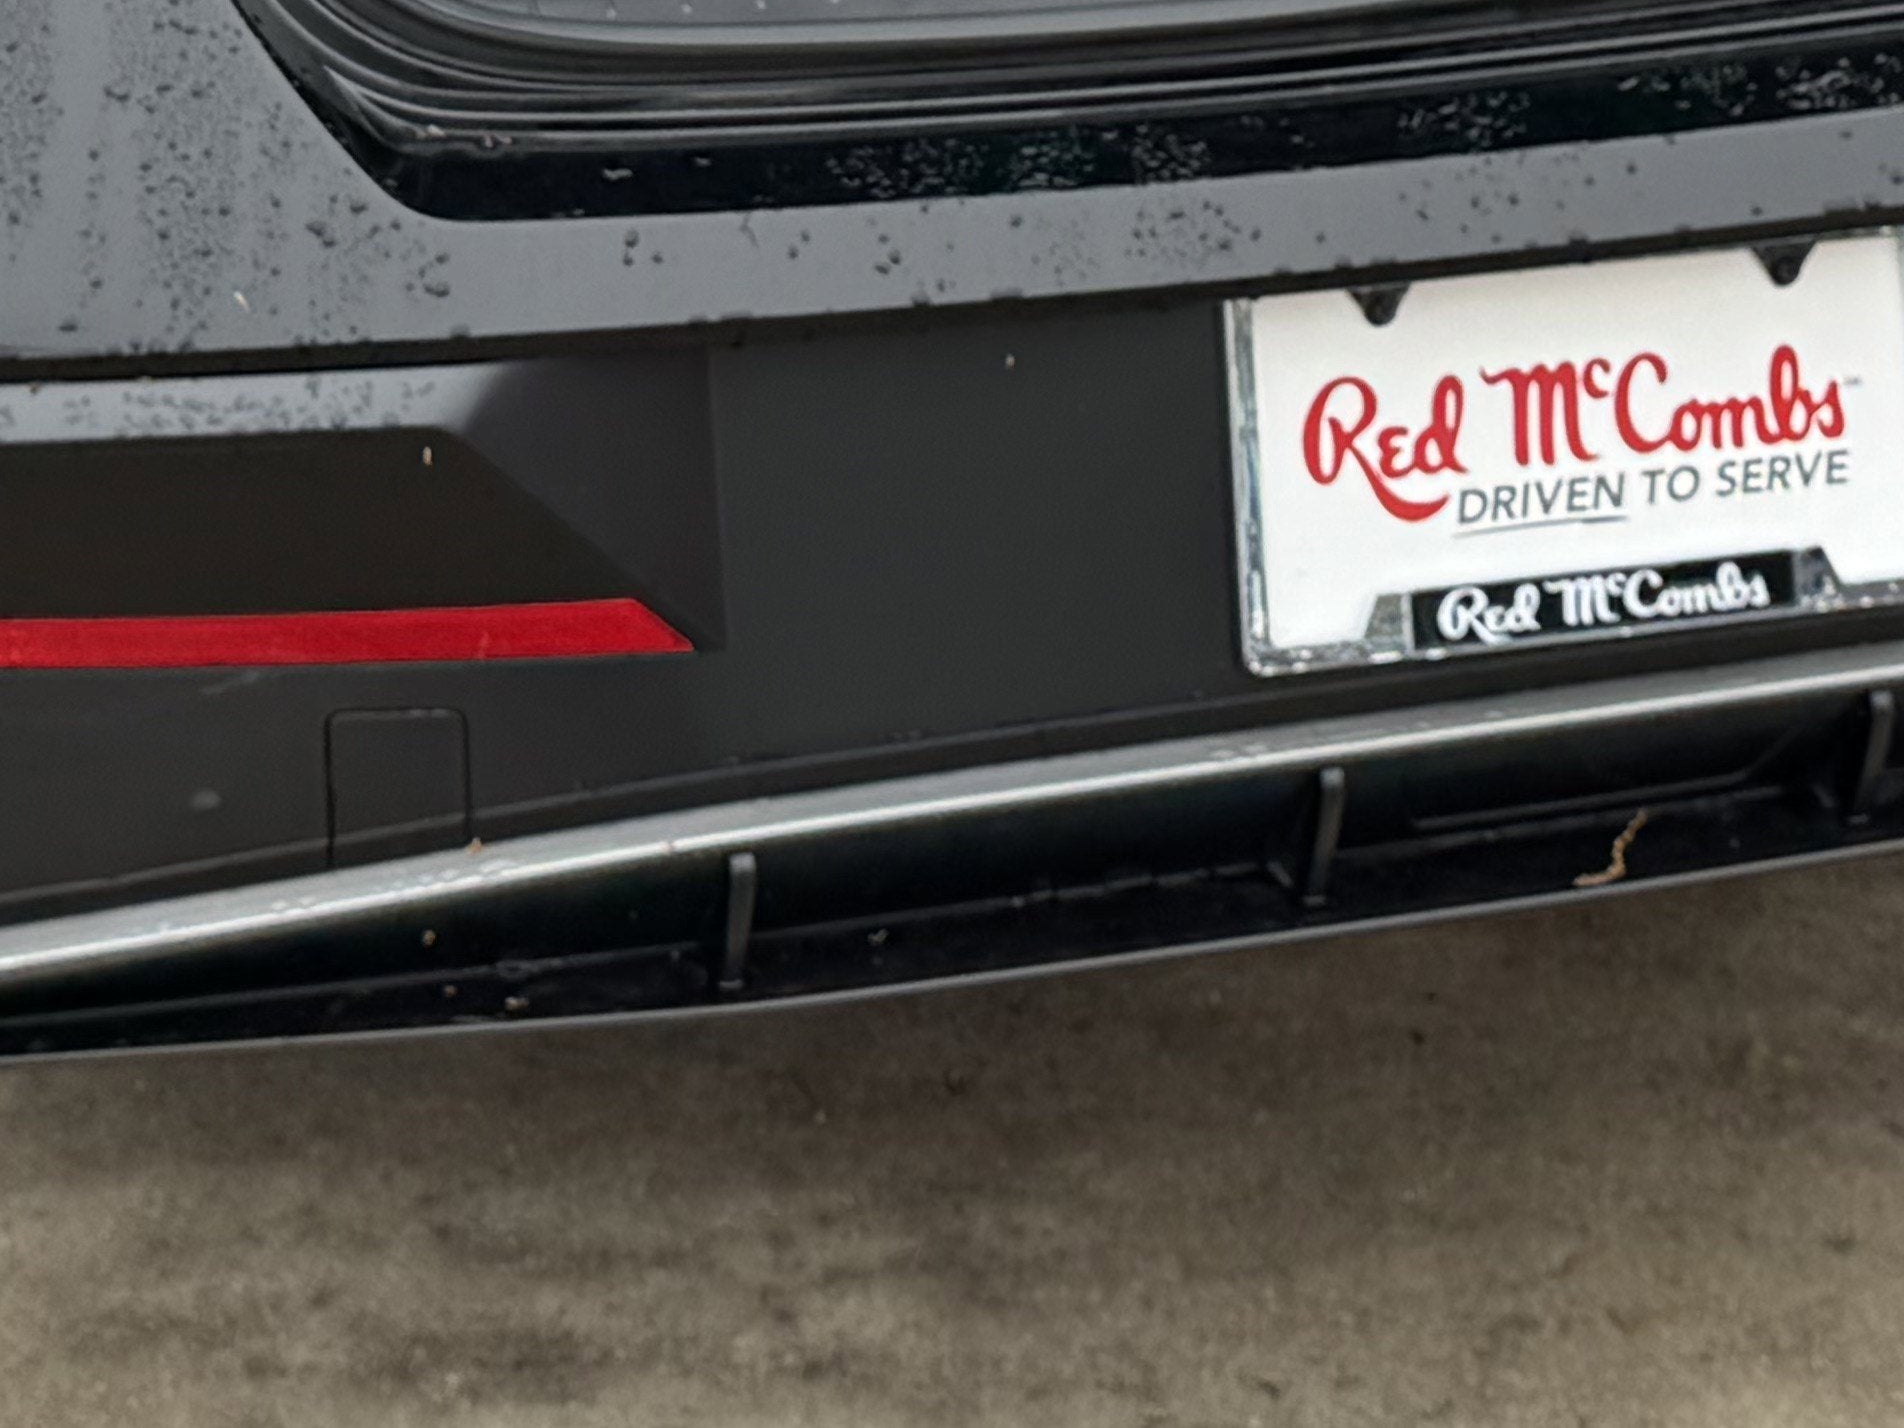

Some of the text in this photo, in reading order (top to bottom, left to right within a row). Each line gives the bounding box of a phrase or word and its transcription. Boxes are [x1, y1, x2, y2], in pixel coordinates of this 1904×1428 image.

[1302, 341, 1846, 523] Red McCombs
[1456, 447, 1850, 524] DRIVEN TO SERVE
[1436, 560, 1772, 645] Red McCombs
